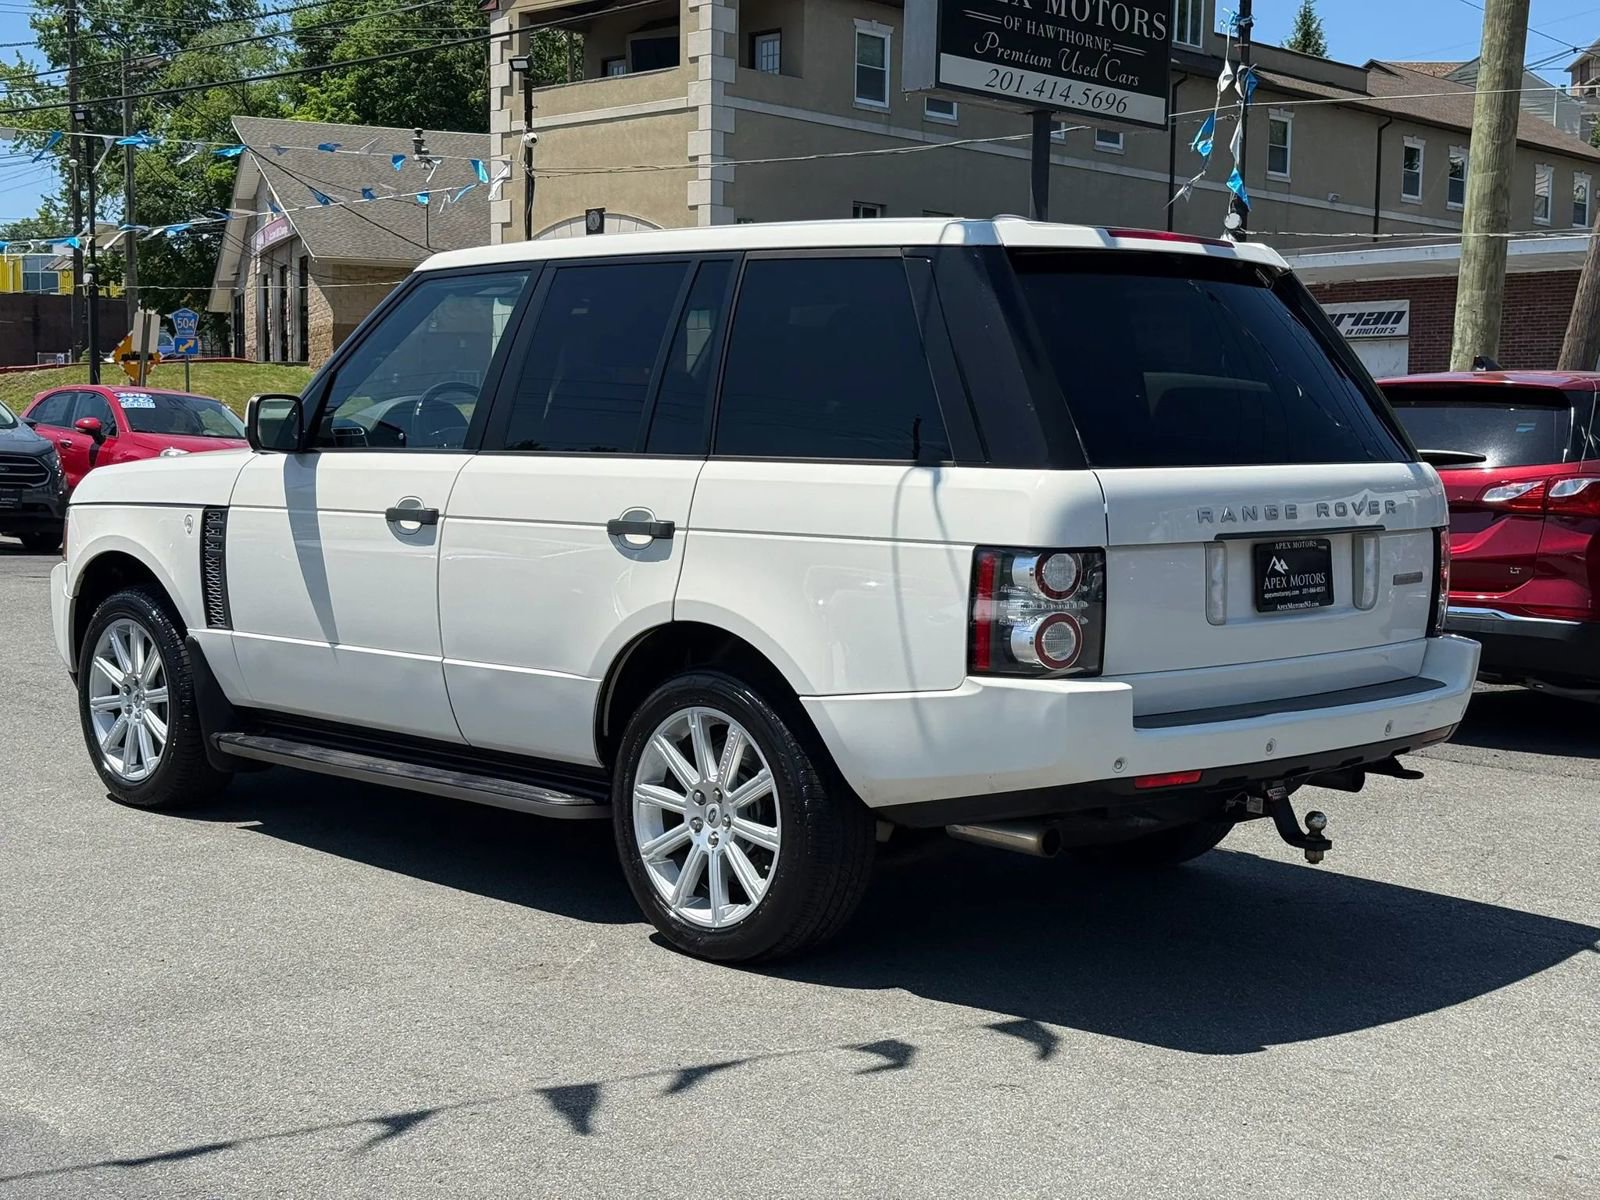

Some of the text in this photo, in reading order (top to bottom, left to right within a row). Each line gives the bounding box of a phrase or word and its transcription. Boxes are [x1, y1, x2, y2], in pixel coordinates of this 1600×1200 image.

[1045, 0, 1167, 41] MOTORS
[1003, 15, 1112, 52] OF HAWTHORNE
[974, 31, 1139, 87] Premium Used Cars
[984, 68, 1130, 114] 201.414.5696
[177, 317, 195, 328] 504
[1355, 326, 1397, 336] motors
[1197, 499, 1397, 524] RANGE ROVER
[1274, 540, 1317, 550] APEX MOTORS
[1264, 572, 1326, 590] APEX MOTORS
